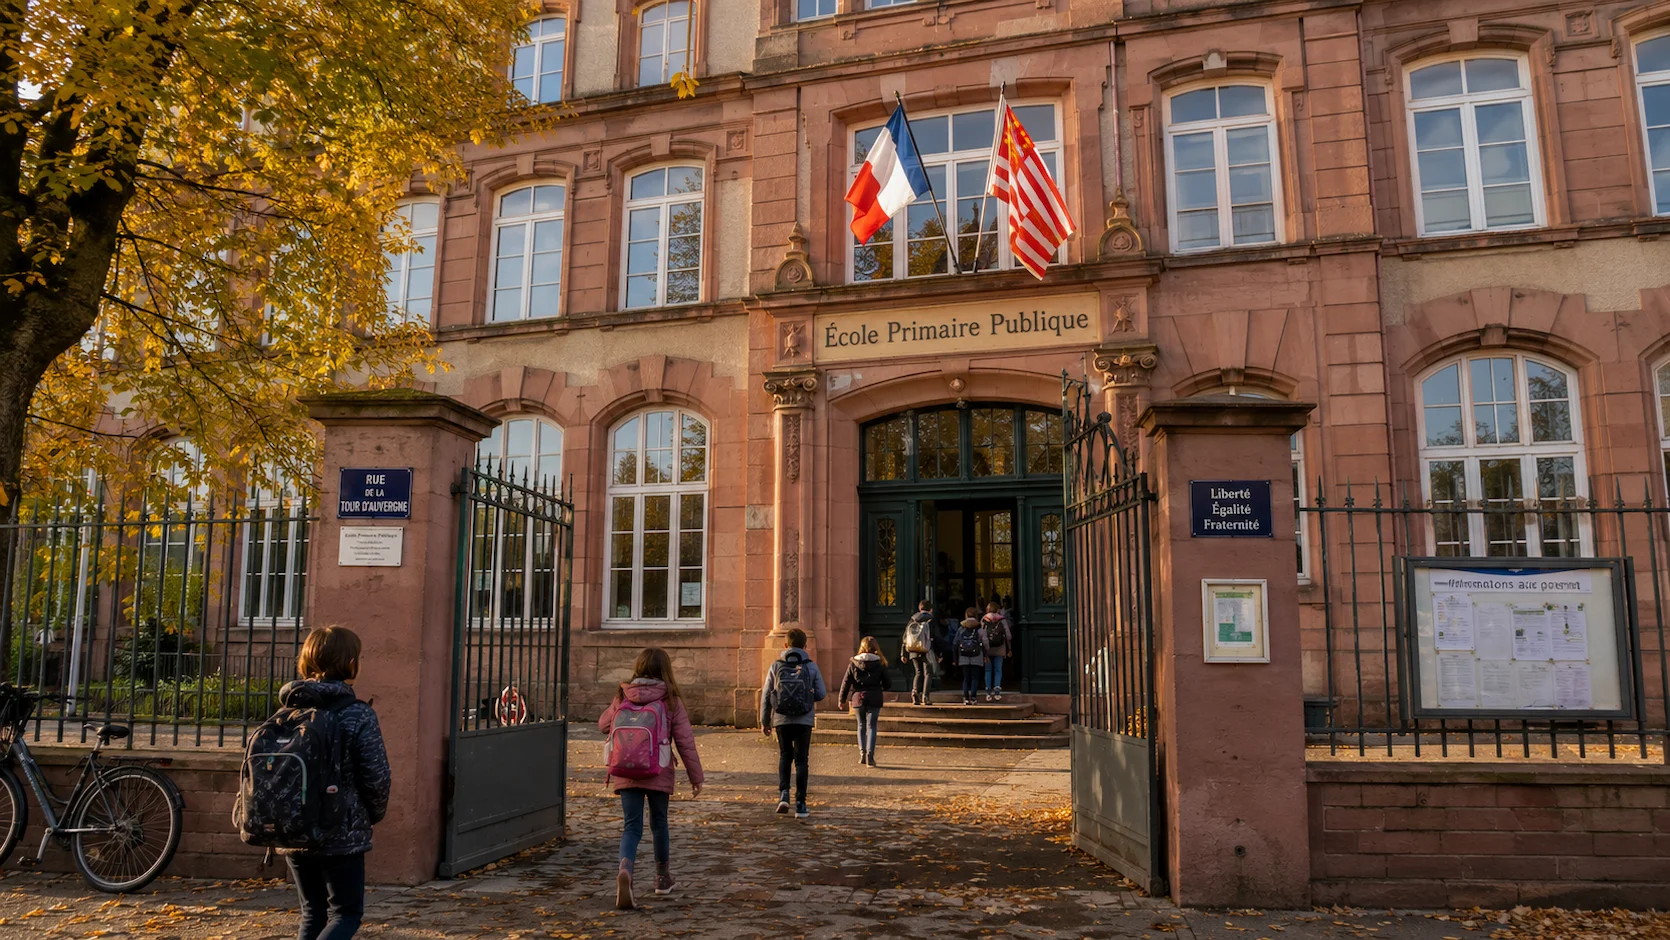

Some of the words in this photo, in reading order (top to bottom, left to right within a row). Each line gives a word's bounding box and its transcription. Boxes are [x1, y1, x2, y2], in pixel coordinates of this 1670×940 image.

[824, 322, 879, 348] École
[887, 318, 980, 343] Primaire
[990, 310, 1089, 336] Publique
[366, 474, 386, 485] RUE
[365, 488, 374, 497] DE
[376, 489, 385, 497] LA
[1210, 488, 1251, 499] Liberté
[341, 501, 360, 512] TOUR
[1212, 501, 1252, 518] Égalité
[1203, 519, 1260, 530] Fraternité
